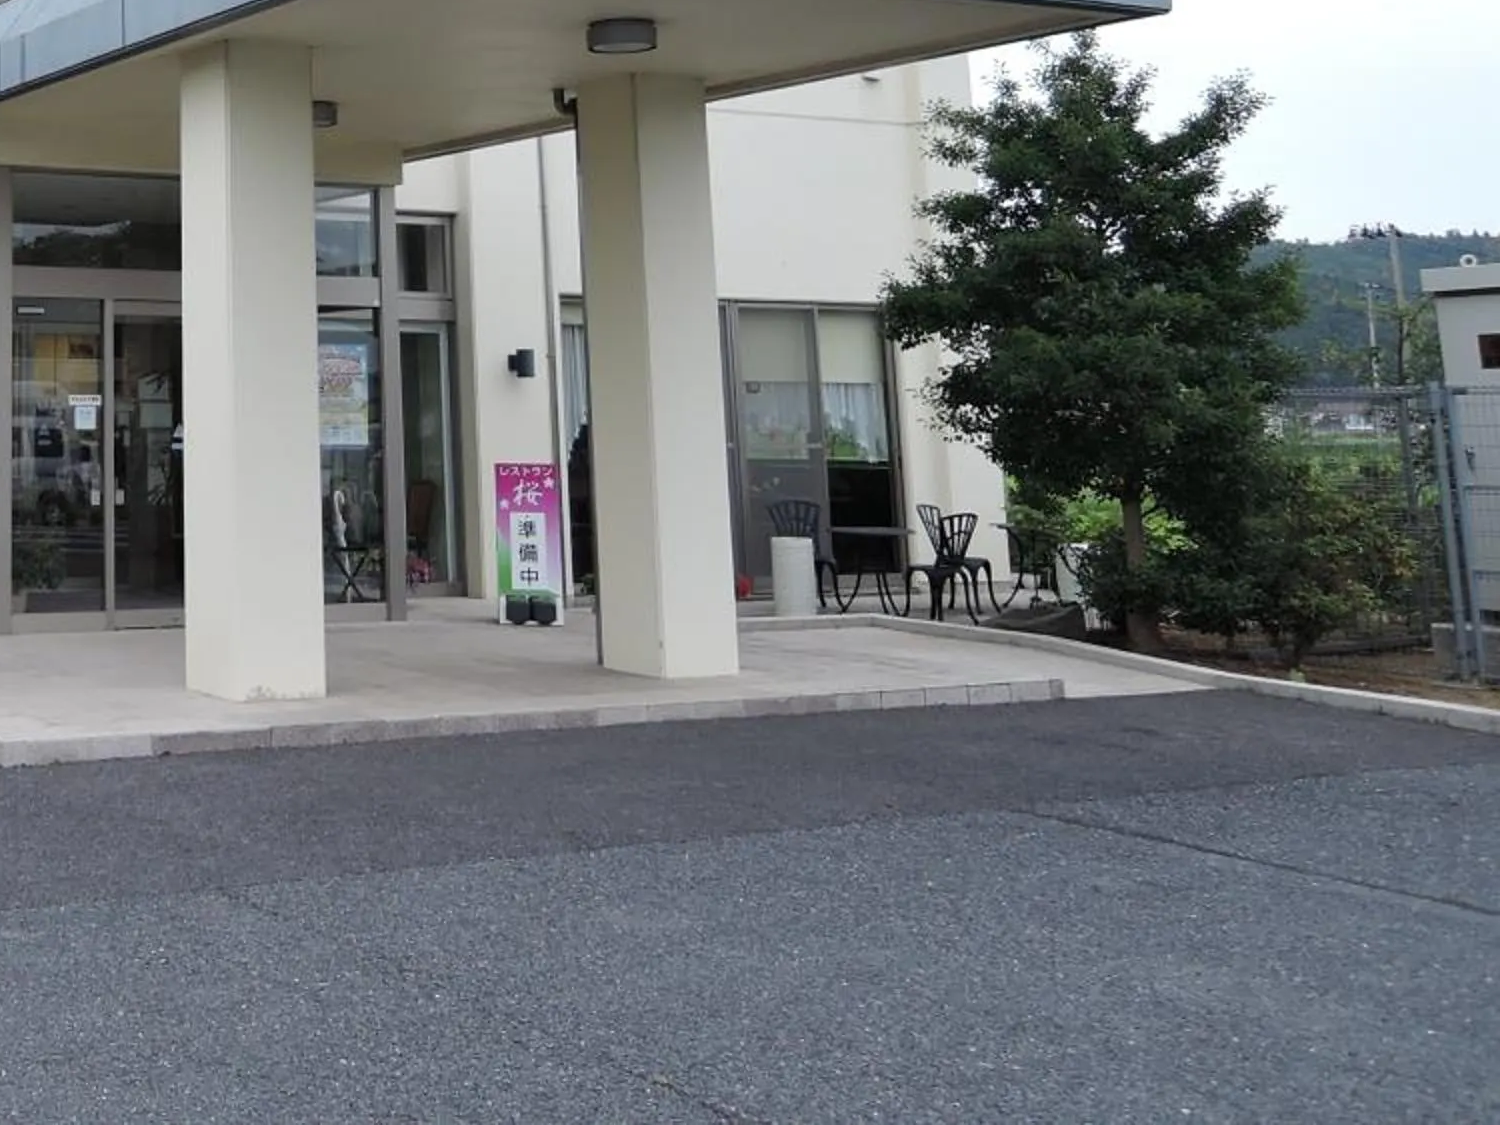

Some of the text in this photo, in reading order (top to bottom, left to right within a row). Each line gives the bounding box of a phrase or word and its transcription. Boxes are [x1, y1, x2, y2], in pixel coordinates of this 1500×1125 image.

[499, 466, 553, 476] レストラン
[512, 478, 543, 506] 桜
[518, 520, 539, 586] 準備中
